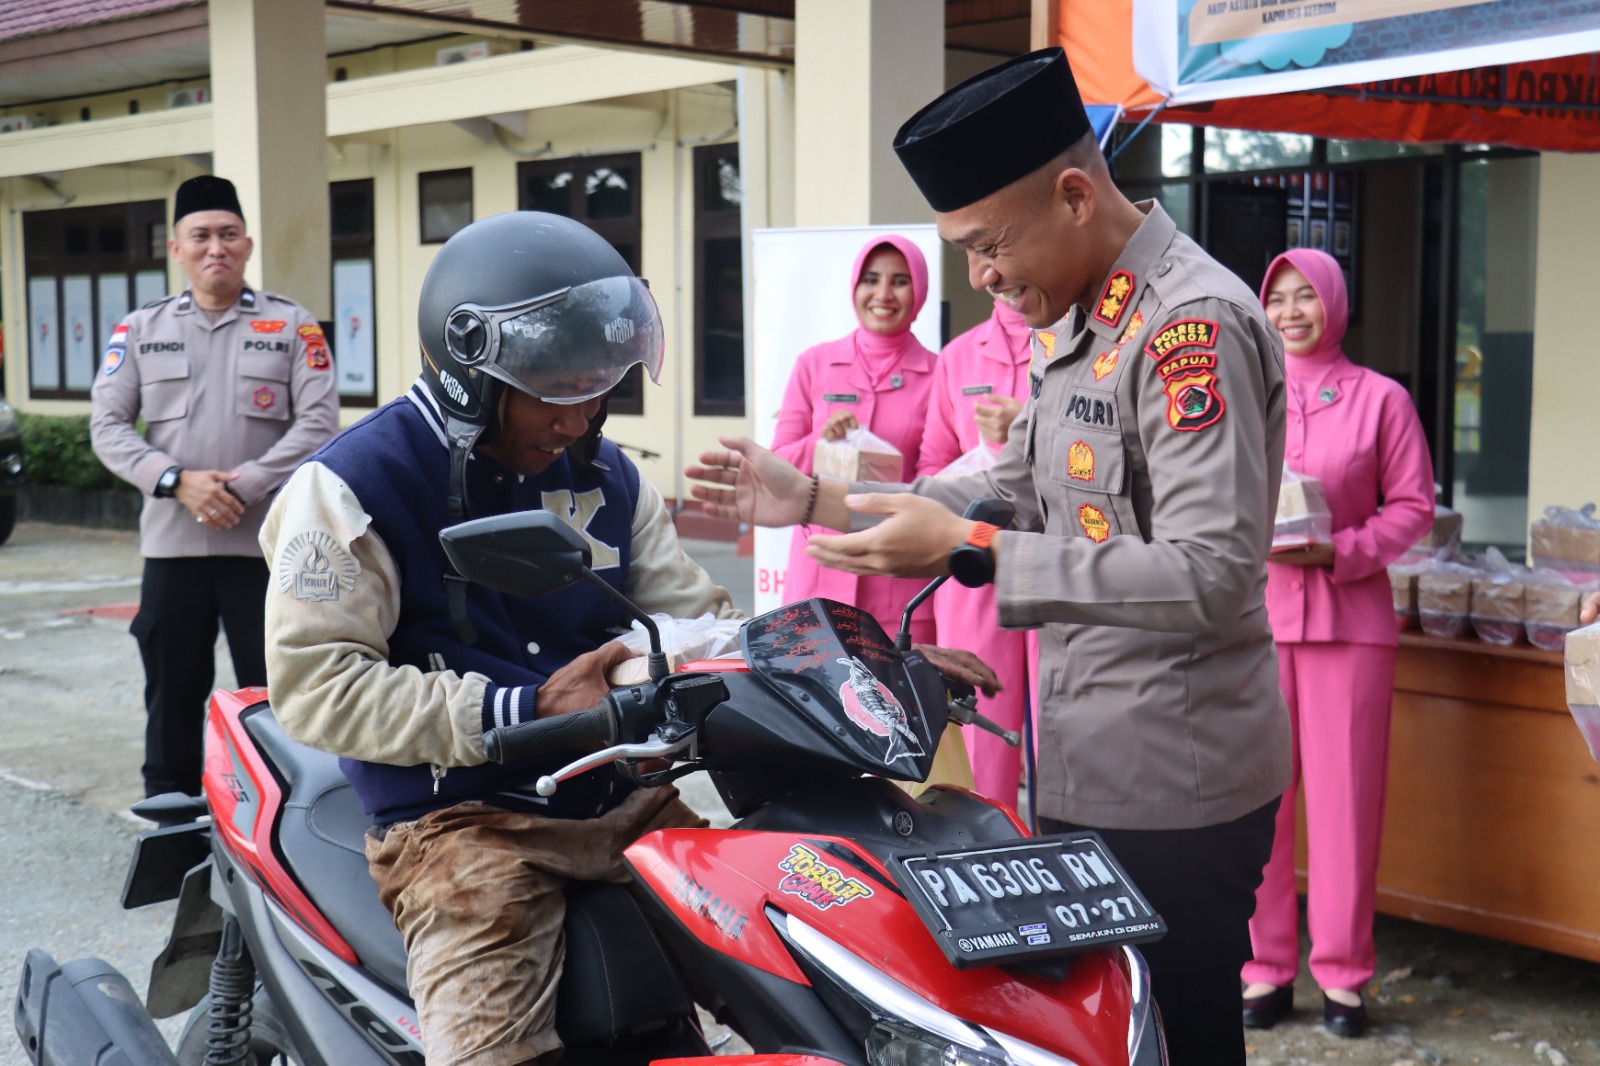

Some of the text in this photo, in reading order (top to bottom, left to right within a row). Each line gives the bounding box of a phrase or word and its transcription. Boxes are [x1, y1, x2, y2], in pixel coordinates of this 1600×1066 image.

[1262, 7, 1301, 23] KAPOLRES
[1153, 323, 1206, 347] POLRES
[1157, 333, 1208, 355] KEEROM
[139, 341, 185, 354] EFENDI
[244, 340, 289, 354] POLRI
[1162, 356, 1208, 375] PAPUA
[1065, 394, 1114, 427] POLRI
[221, 773, 250, 803] 155
[921, 868, 980, 907] PA
[971, 857, 1064, 899] 6306
[671, 870, 748, 940] YAMAHA
[1125, 922, 1159, 932] DEPAN
[970, 932, 1018, 950] YAMAHA
